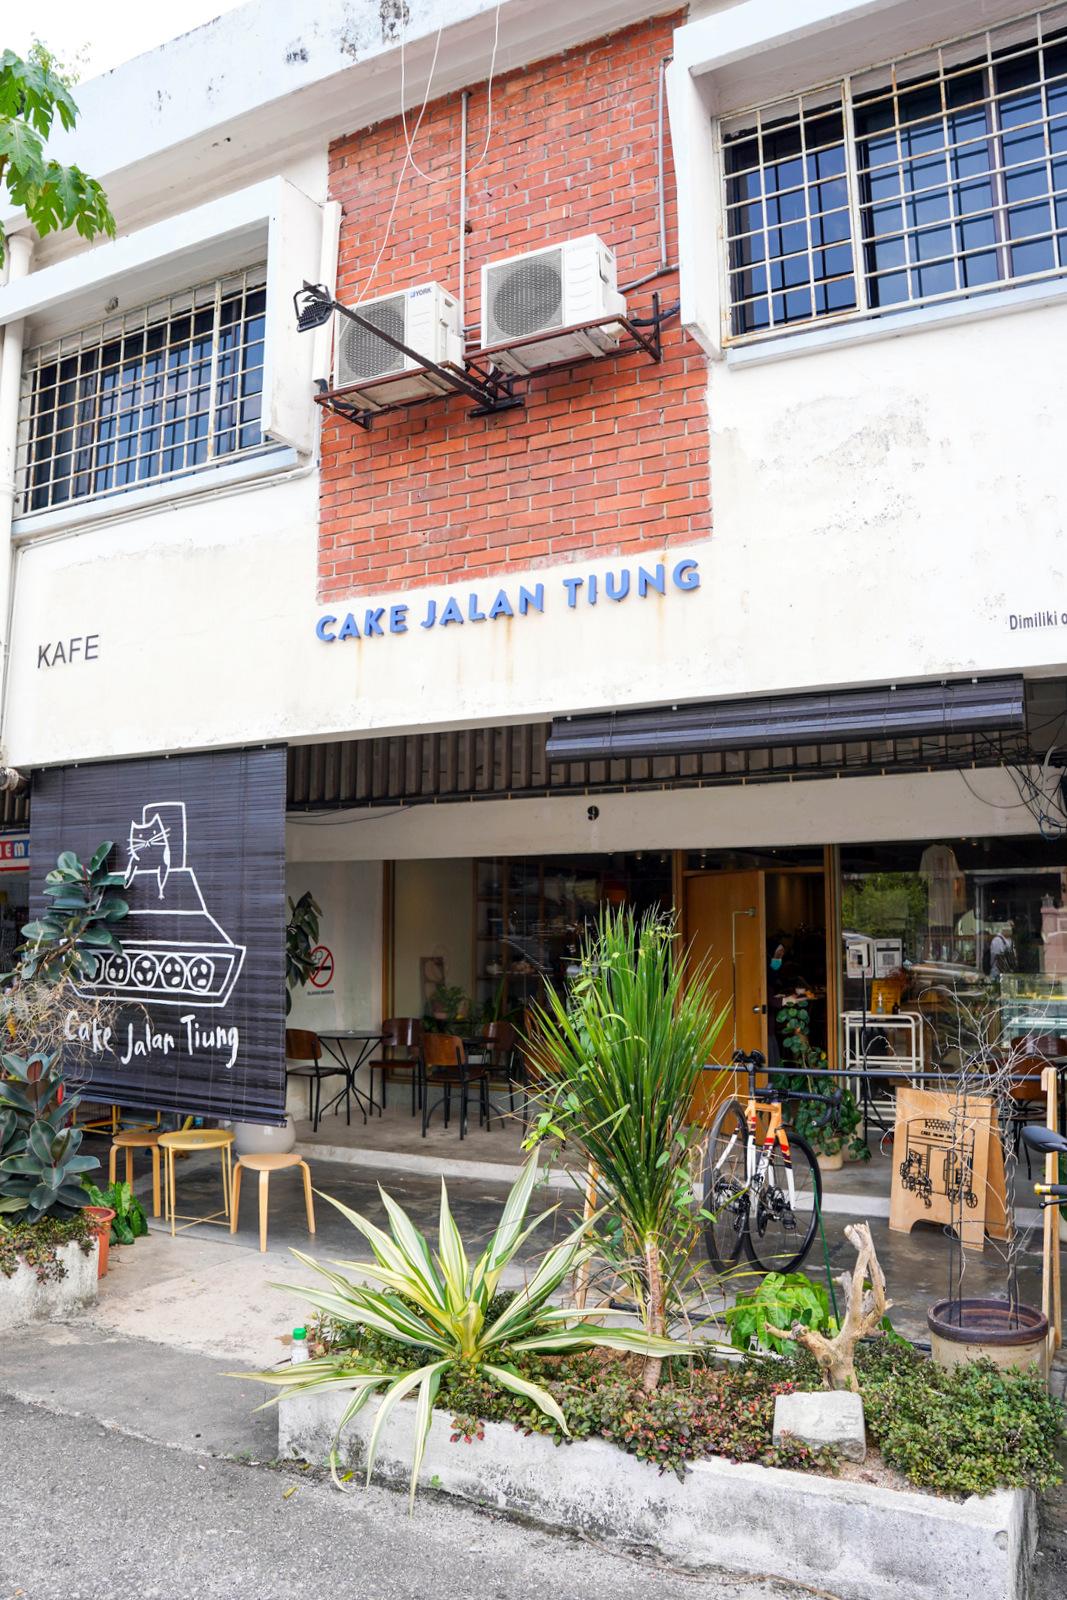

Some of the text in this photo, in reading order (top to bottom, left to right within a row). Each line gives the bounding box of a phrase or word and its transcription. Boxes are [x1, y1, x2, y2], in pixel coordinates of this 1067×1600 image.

[315, 559, 700, 643] CAKE JALAN TIUNG
[1009, 611, 1058, 630] Dimiliki
[37, 634, 99, 668] KAFE
[587, 805, 600, 821] 9
[64, 1010, 239, 1069] Cake Jalan Tiung
